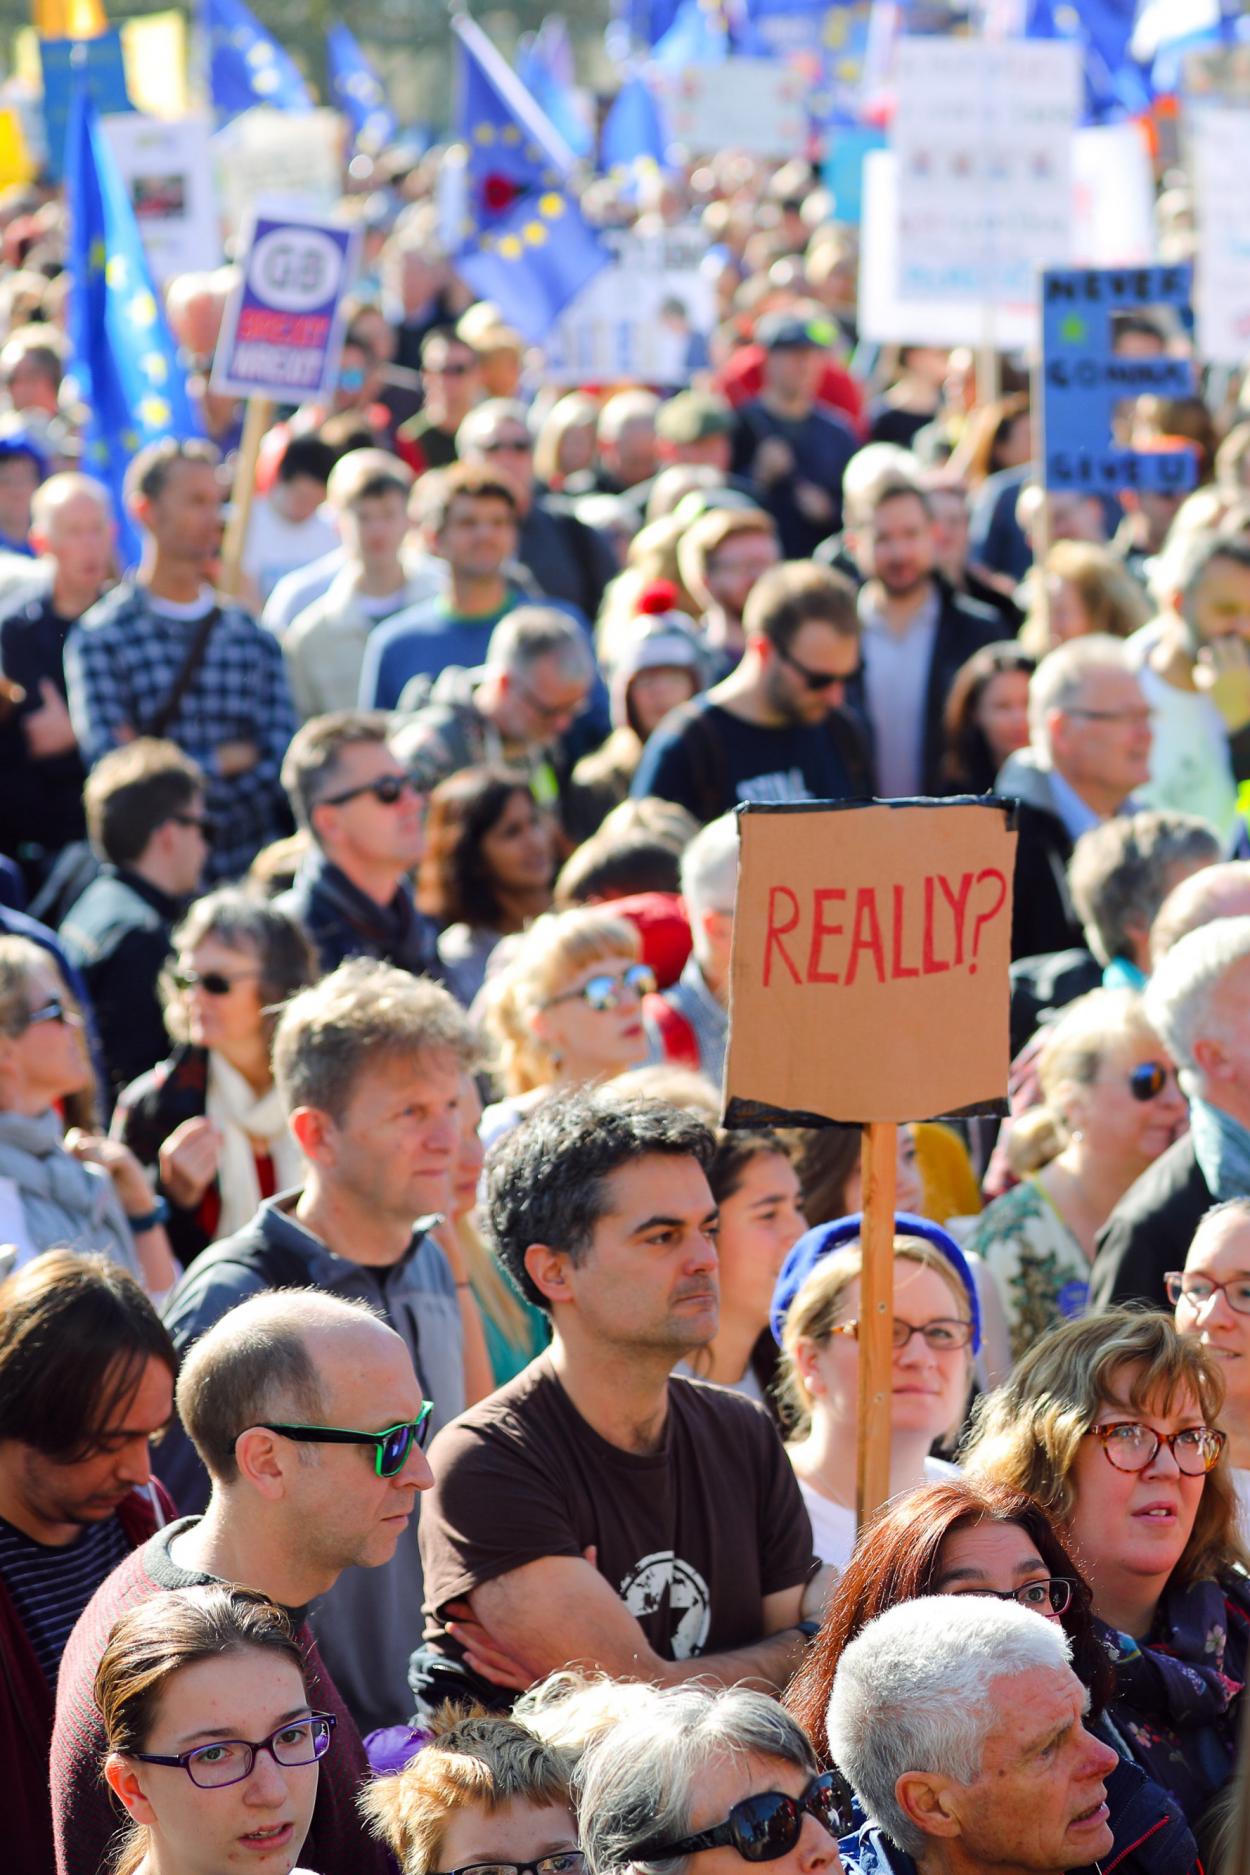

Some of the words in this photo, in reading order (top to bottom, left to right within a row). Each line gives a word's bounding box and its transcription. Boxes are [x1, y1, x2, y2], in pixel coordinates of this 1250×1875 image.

[262, 242, 327, 293] GB
[1049, 266, 1183, 300] NEVER
[1048, 359, 1187, 390] GONNA
[1049, 451, 1138, 483] GIVE
[763, 868, 1006, 987] REALLY?
